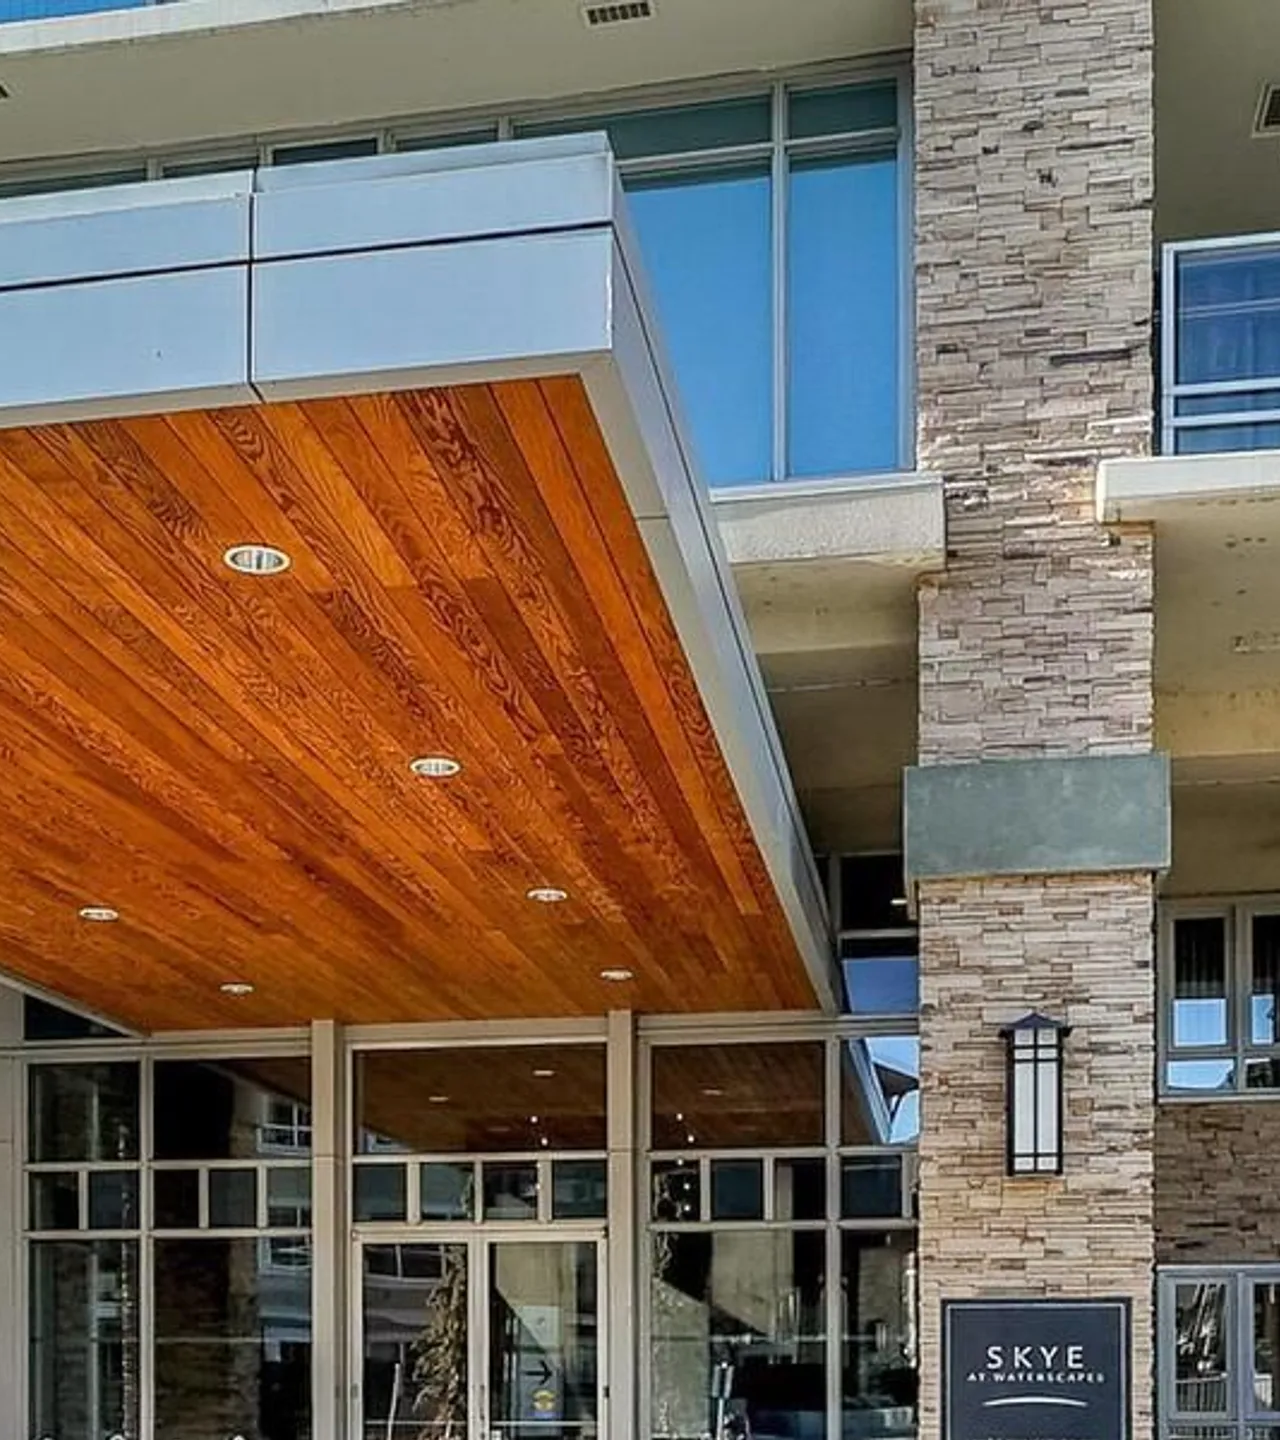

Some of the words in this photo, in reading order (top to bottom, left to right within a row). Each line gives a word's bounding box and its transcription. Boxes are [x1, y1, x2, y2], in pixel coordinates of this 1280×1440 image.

[986, 1345, 1084, 1370] SKYE
[966, 1372, 986, 1382] AT
[993, 1372, 1105, 1383] WATERSCAPES
